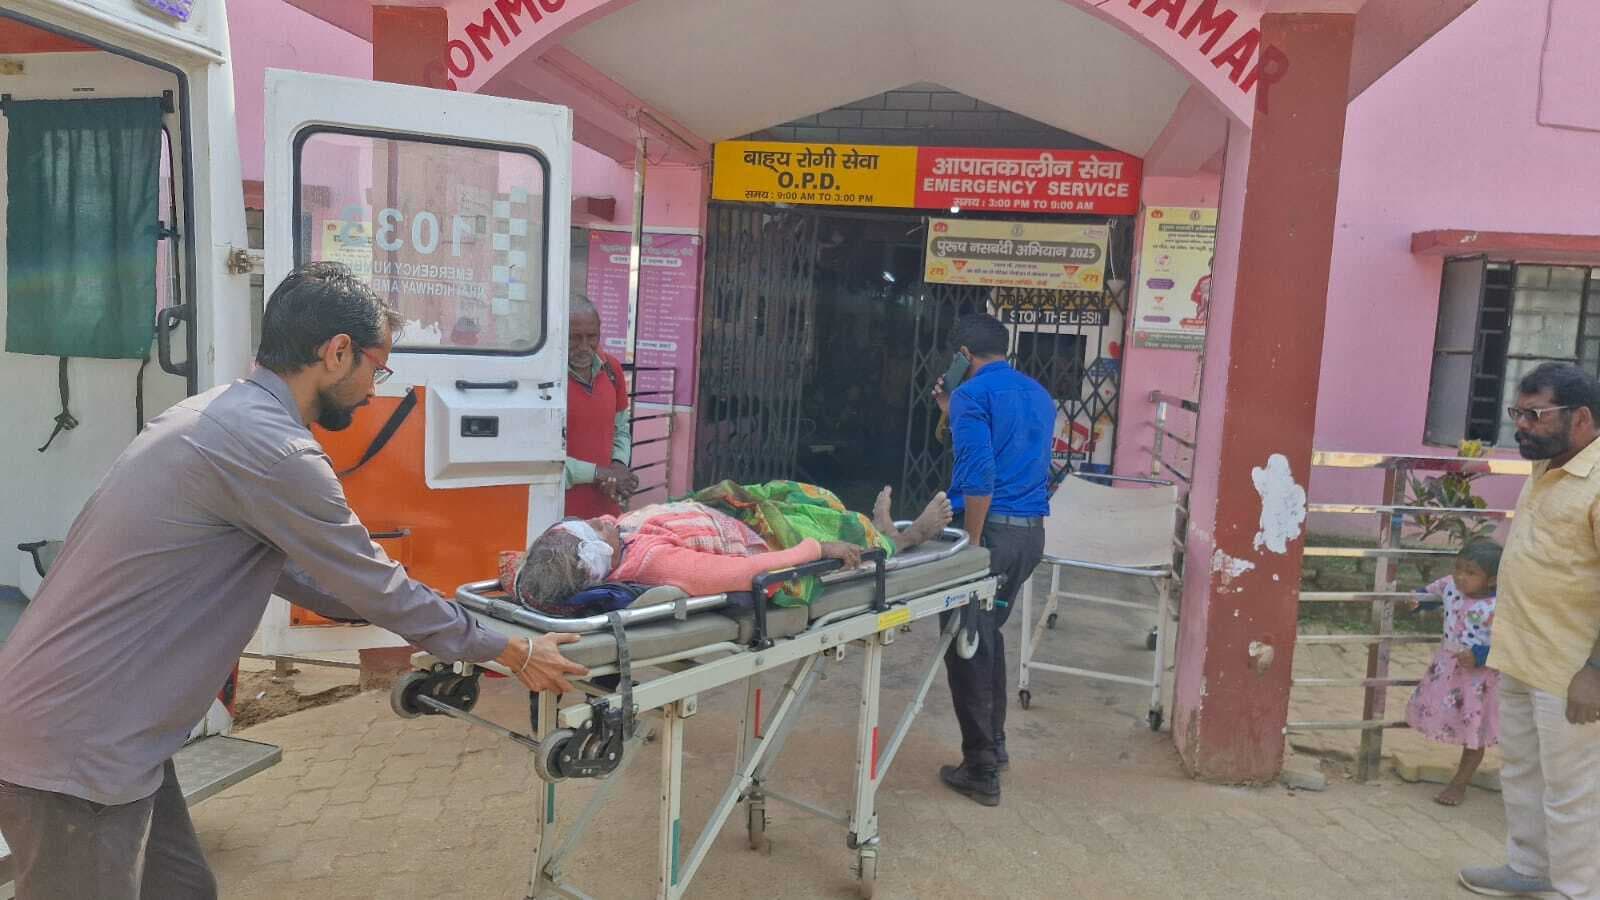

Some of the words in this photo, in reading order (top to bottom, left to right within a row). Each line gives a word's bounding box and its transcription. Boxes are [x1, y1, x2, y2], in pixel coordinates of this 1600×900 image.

[1128, 0, 1289, 115] AMAR
[796, 147, 837, 169] रोगी
[842, 148, 880, 170] सेवा
[932, 152, 1074, 179] आपातकालीन
[1078, 155, 1123, 180] सेवा
[777, 171, 841, 191] O.P.D.
[923, 178, 1037, 195] EMERGENCY
[1047, 181, 1129, 197] SERVICE
[776, 191, 797, 200] 9:00
[800, 192, 816, 201] AM
[819, 193, 832, 201] TO
[834, 192, 855, 202] 3:00
[858, 194, 873, 203] PM
[988, 198, 1009, 208] 3:00
[1013, 199, 1030, 209] PM
[1033, 200, 1047, 209] TO
[1077, 201, 1094, 210] AM
[1015, 243, 1067, 257] अभियान
[1069, 247, 1096, 258] 2025
